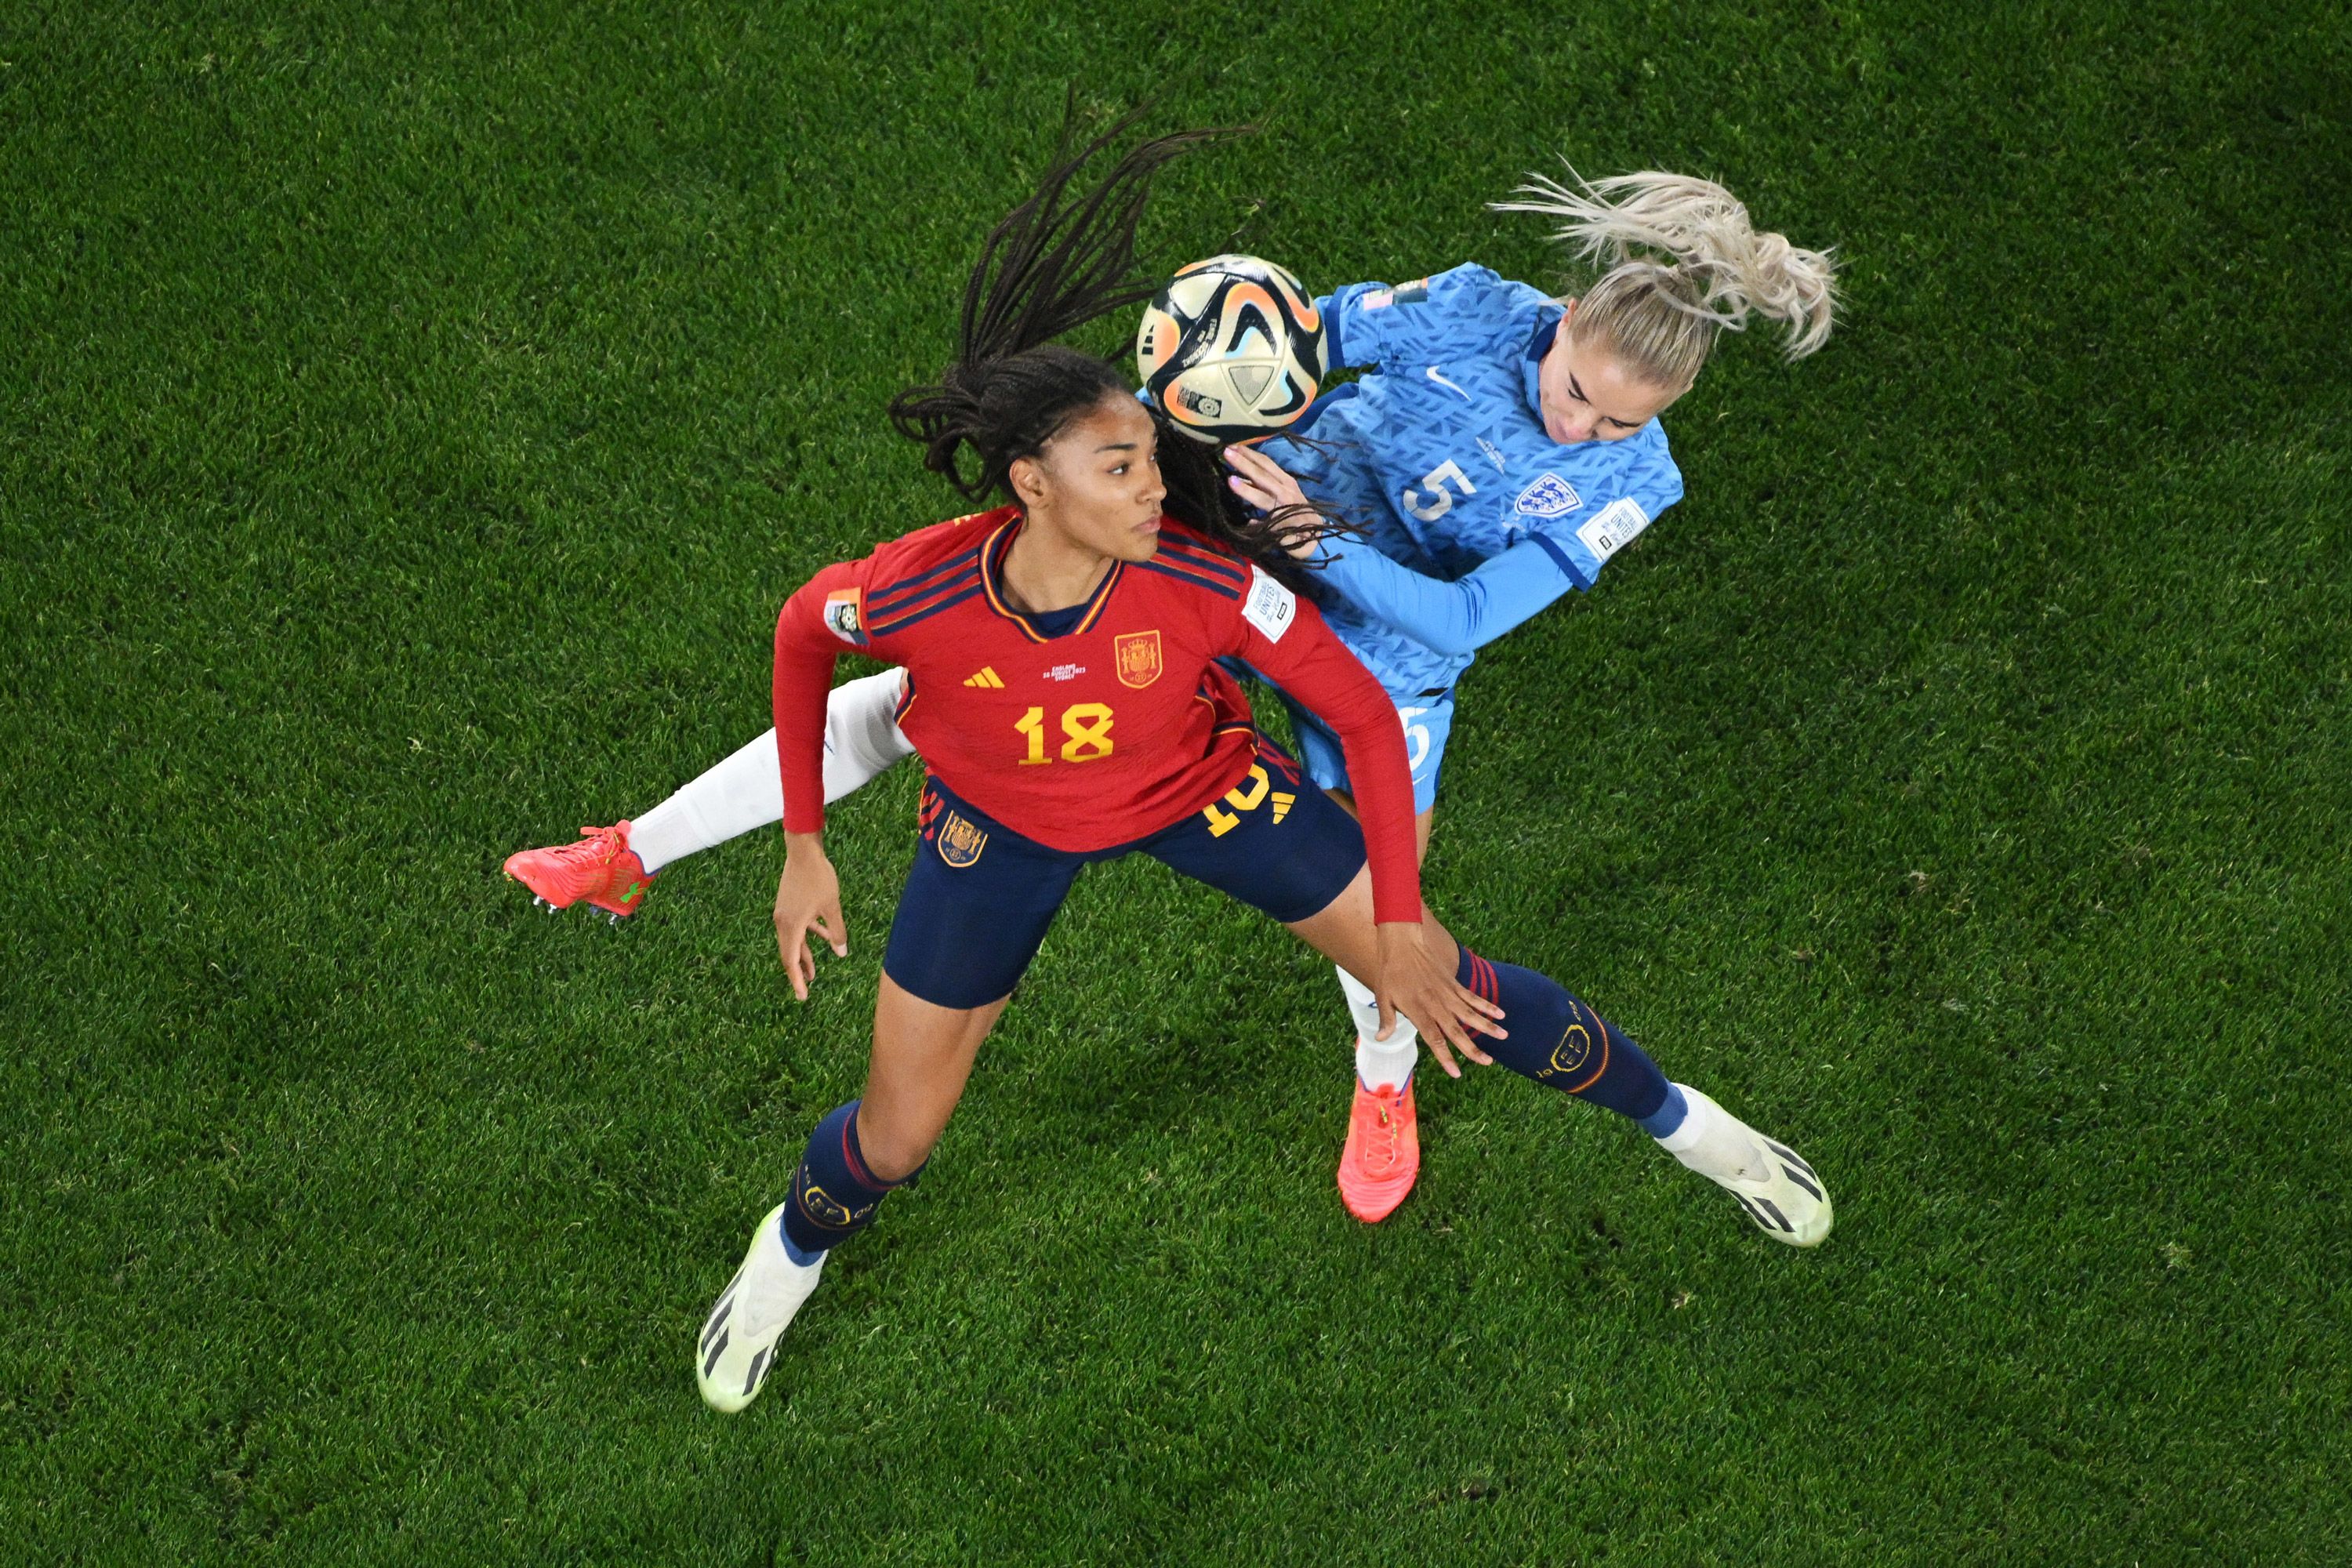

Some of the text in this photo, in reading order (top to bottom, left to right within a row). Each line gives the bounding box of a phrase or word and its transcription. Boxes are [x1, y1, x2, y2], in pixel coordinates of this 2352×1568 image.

[1403, 459, 1477, 522] 5
[1610, 514, 1633, 539] UNITES
[1259, 583, 1276, 615] UNITES
[1051, 663, 1076, 672] ENGLAND
[1054, 673, 1075, 682] SYDNEY
[1014, 702, 1114, 764] 18
[1398, 706, 1430, 772] 5
